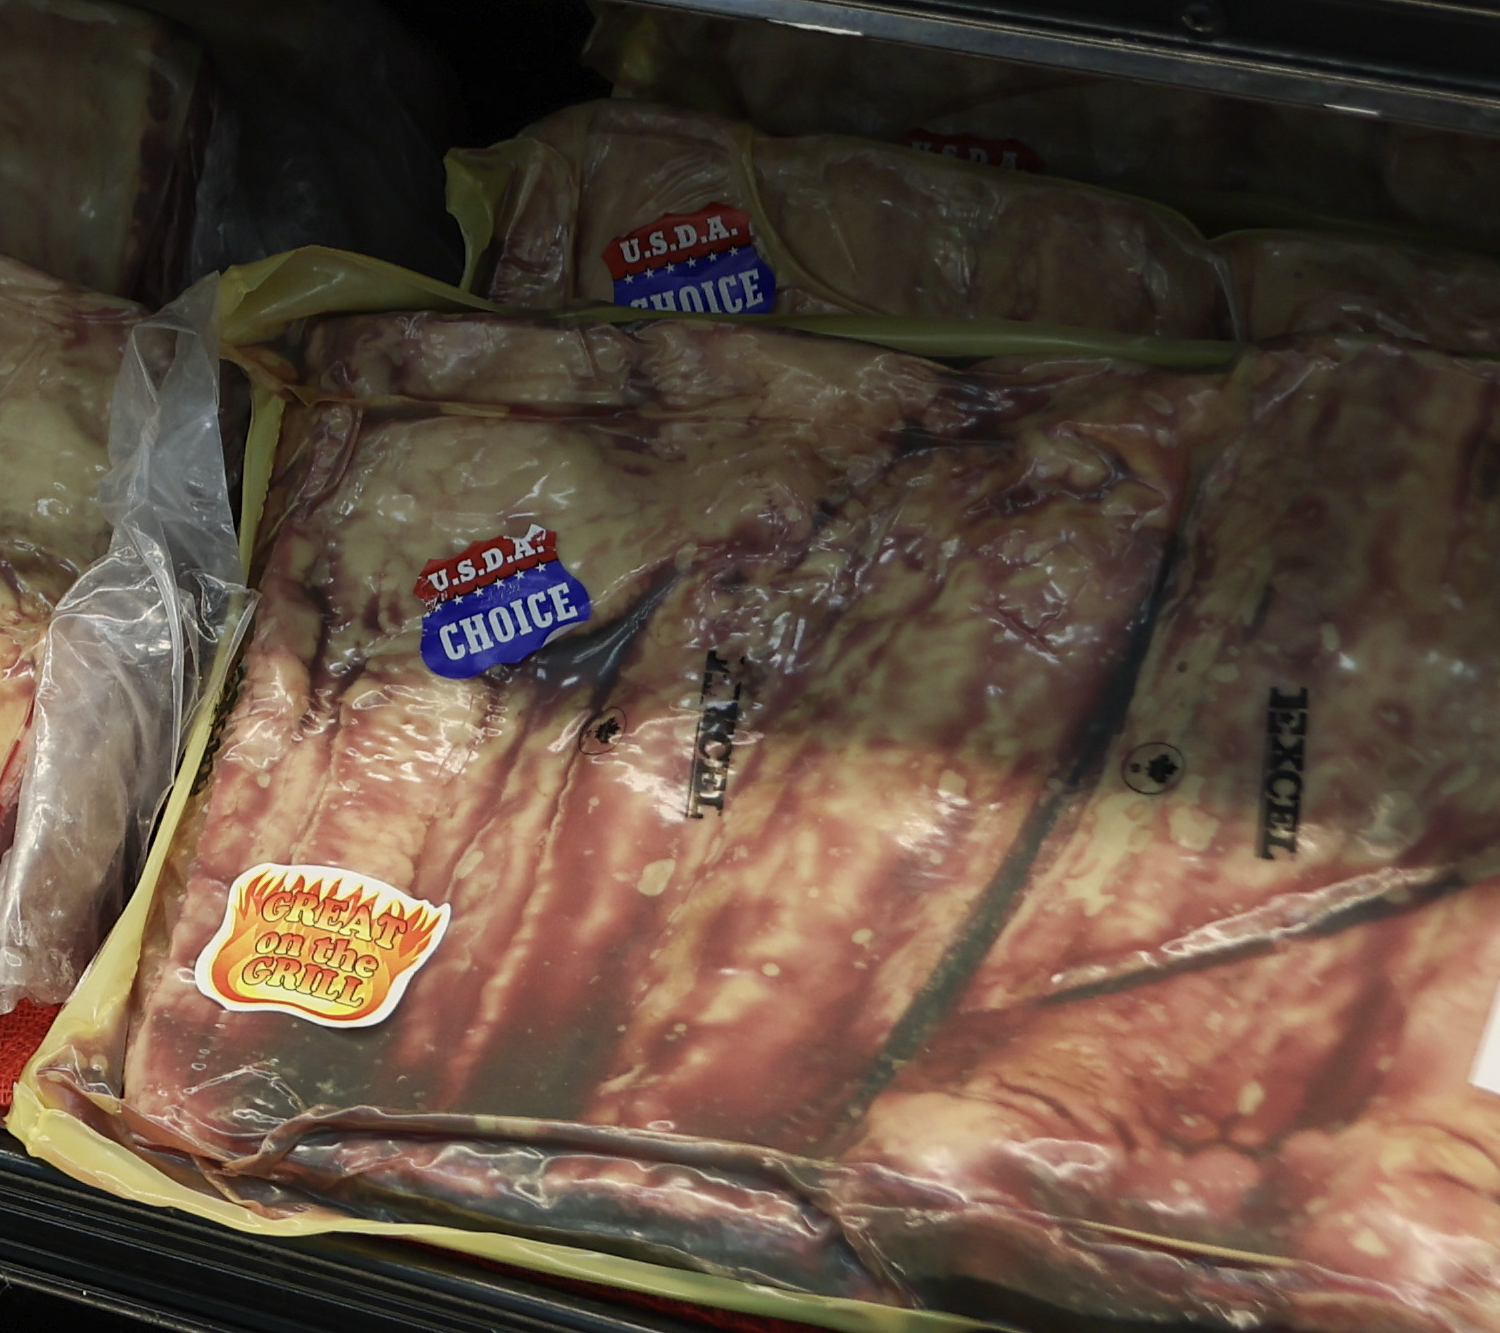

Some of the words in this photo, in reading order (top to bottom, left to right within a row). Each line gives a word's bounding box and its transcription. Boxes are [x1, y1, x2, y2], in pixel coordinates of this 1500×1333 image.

[618, 214, 741, 265] U.S.D.A.
[426, 535, 547, 593] U.S.D.A.
[436, 580, 581, 662] CHOICE
[1253, 686, 1310, 863] EXCEL
[260, 889, 409, 952] GREAT
[240, 956, 365, 1011] GRILL
[255, 930, 303, 956] on
[309, 933, 379, 983] the
